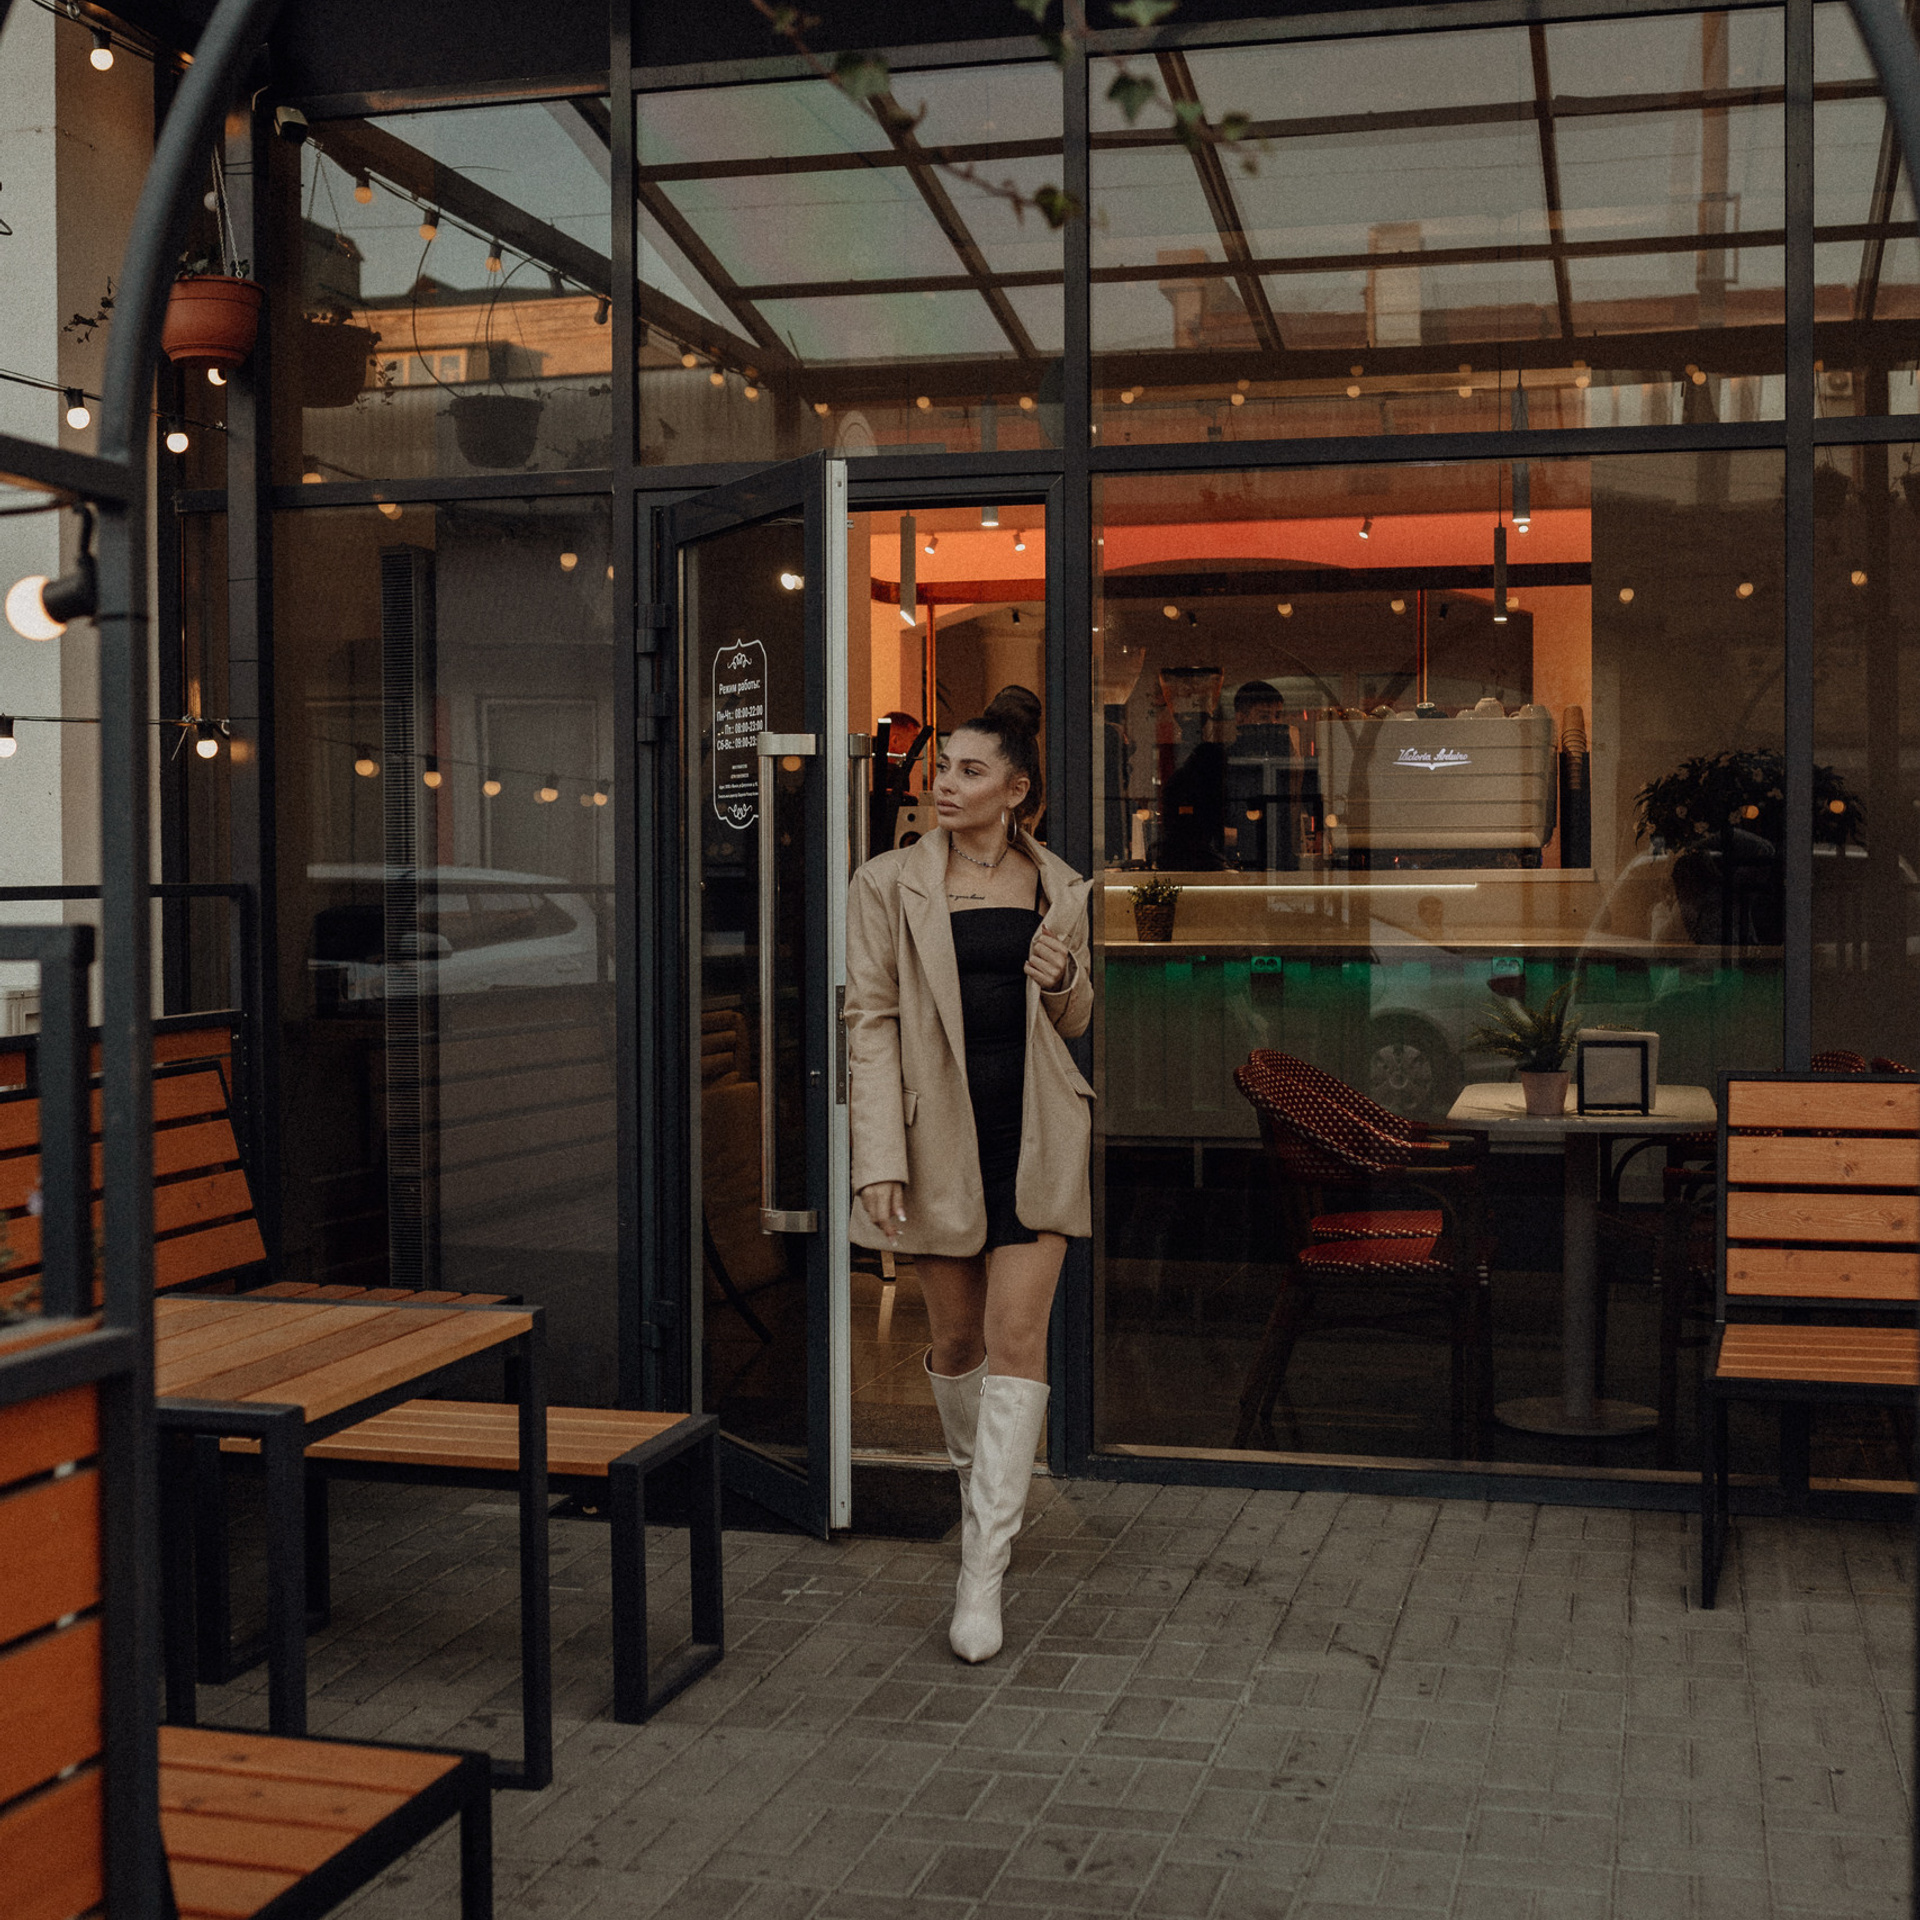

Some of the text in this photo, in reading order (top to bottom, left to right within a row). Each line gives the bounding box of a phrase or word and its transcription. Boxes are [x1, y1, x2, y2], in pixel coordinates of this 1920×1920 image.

[719, 679, 761, 695] Режим работы:
[1398, 747, 1468, 761] Victoria Arduino
